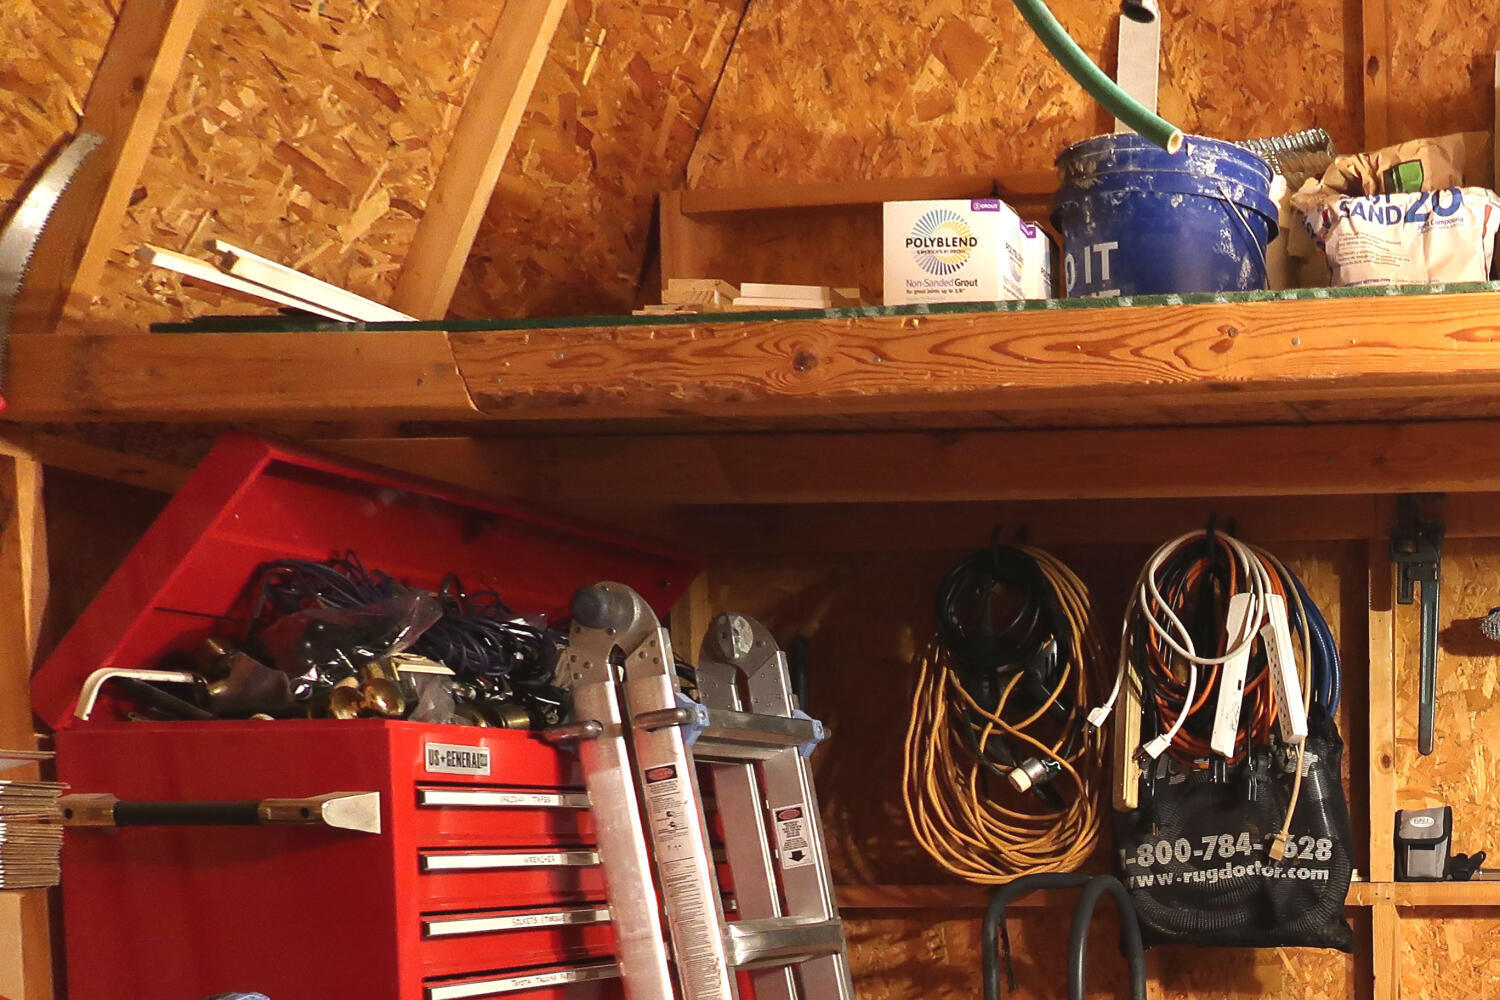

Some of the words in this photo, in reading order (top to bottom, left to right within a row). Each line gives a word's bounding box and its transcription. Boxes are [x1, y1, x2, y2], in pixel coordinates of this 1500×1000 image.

[1338, 200, 1403, 226] SAND
[905, 237, 979, 249] POLYBLEND
[906, 278, 954, 287] Non-Sanded
[954, 278, 978, 288] Grout
[428, 749, 441, 767] US
[446, 750, 481, 768] GENERAL
[1118, 832, 1333, 871] 1-800-784-628
